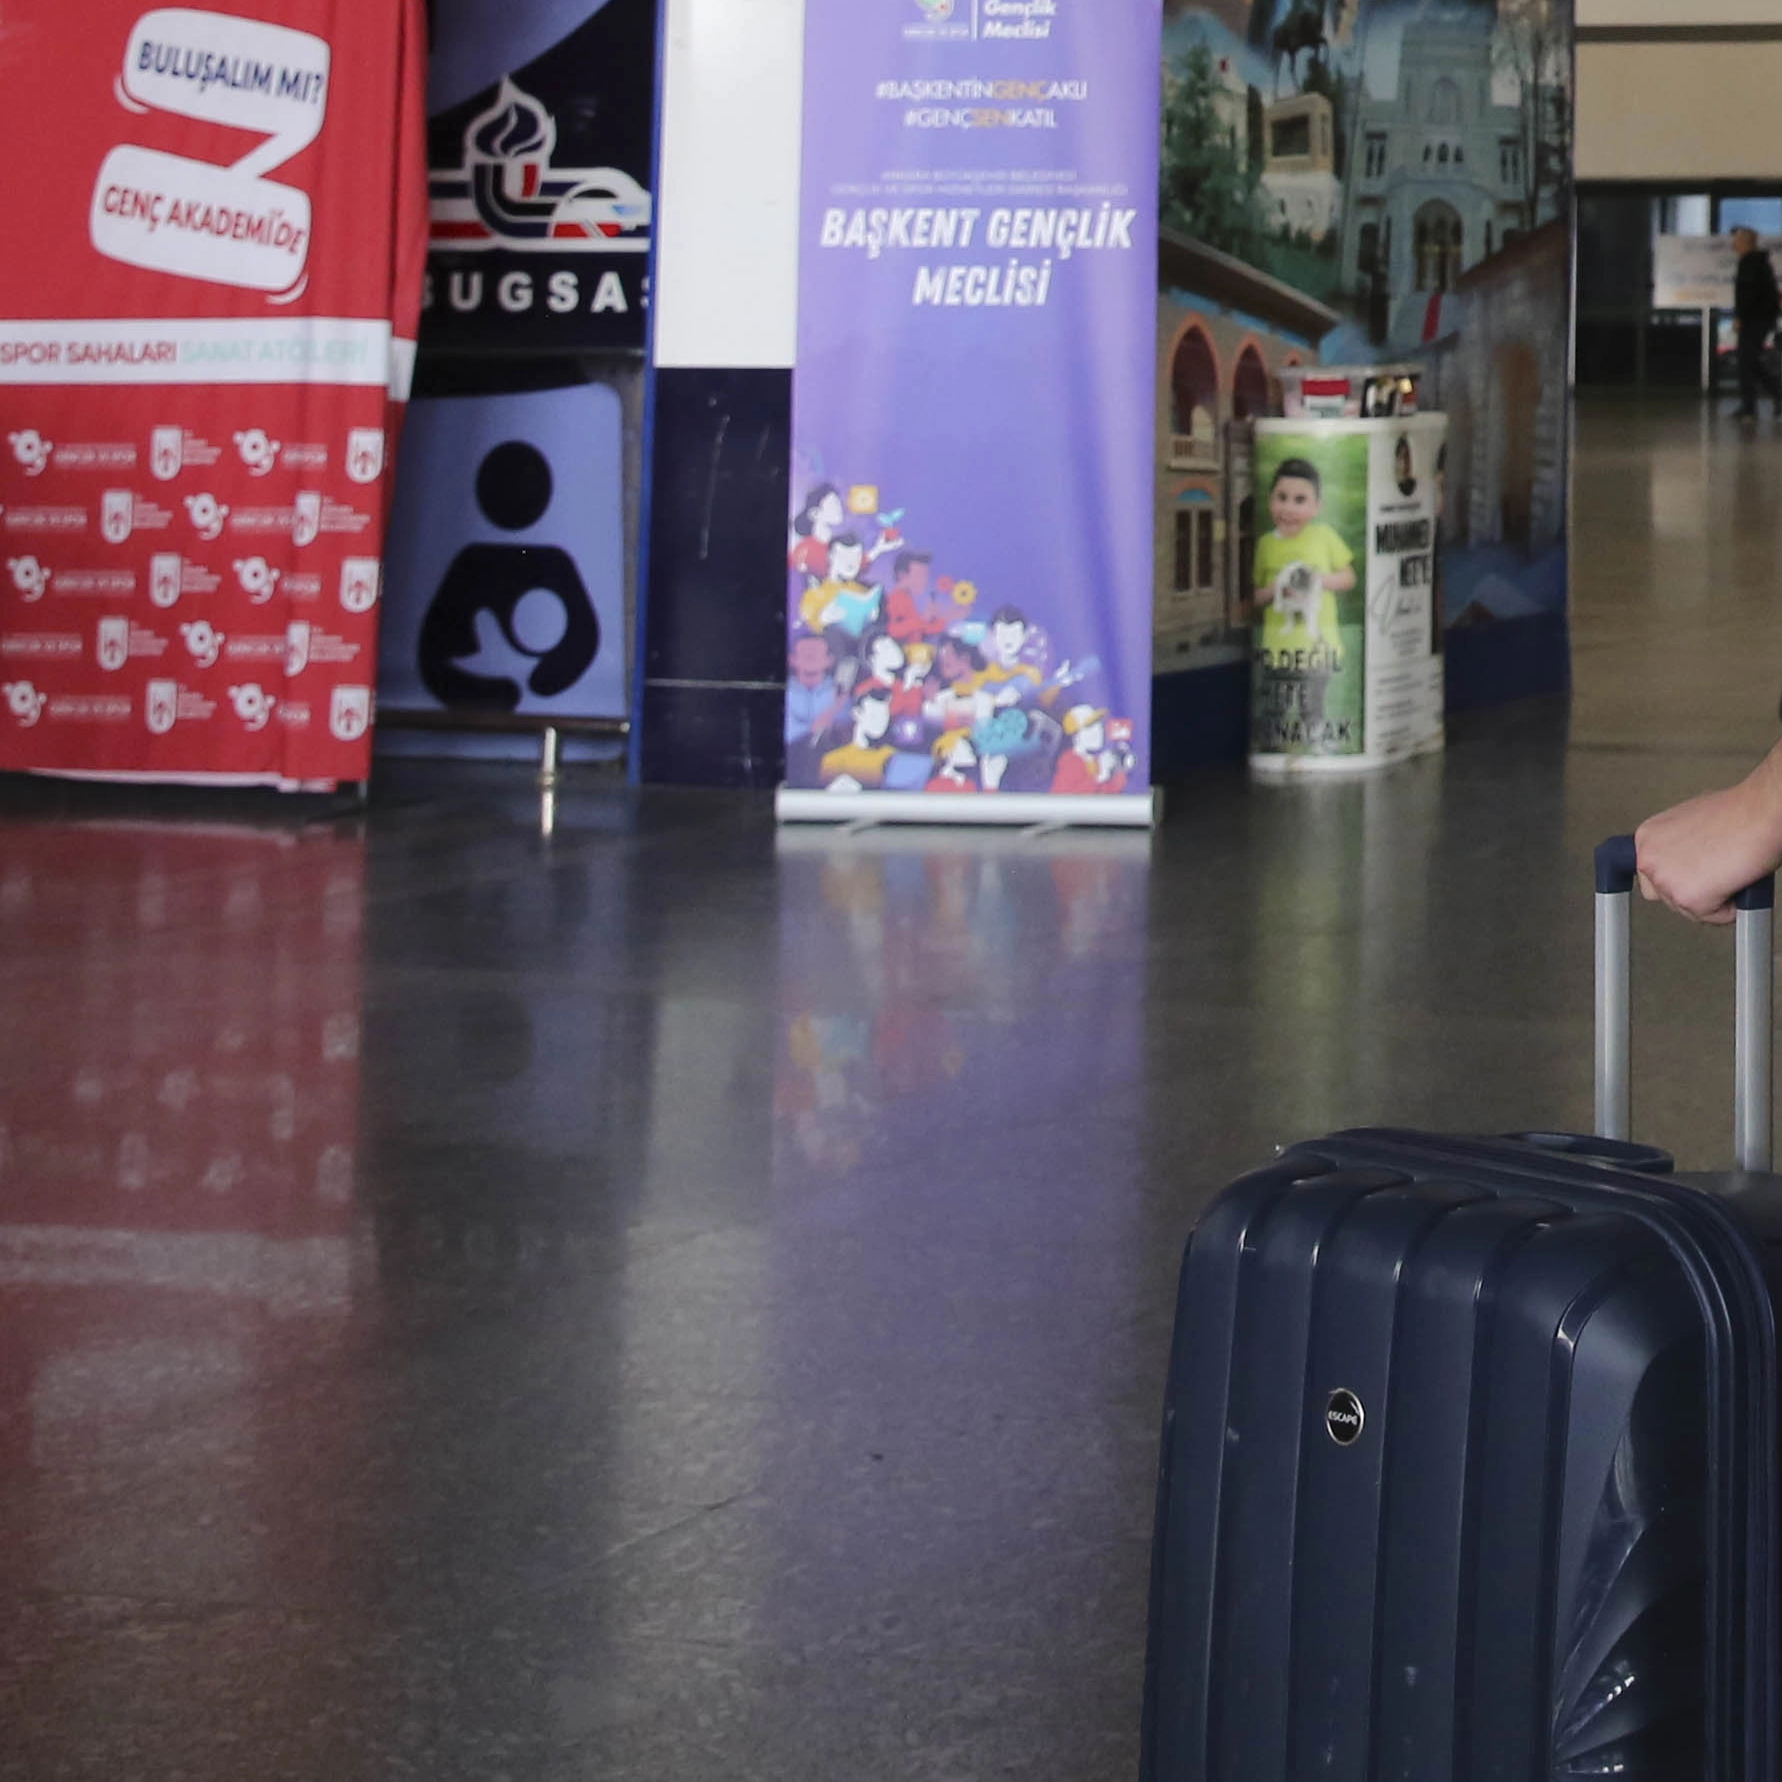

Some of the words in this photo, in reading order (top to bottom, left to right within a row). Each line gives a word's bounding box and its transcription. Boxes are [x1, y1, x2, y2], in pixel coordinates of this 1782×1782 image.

[138, 41, 273, 95] BULUŞALIM
[103, 185, 164, 232] GENÇ
[820, 207, 980, 259] BAŞKENT
[986, 201, 1137, 260] GENÇLİK
[912, 258, 1052, 307] MECLİSİ
[0, 341, 61, 364] SPOR
[67, 341, 177, 365] SAHALARI
